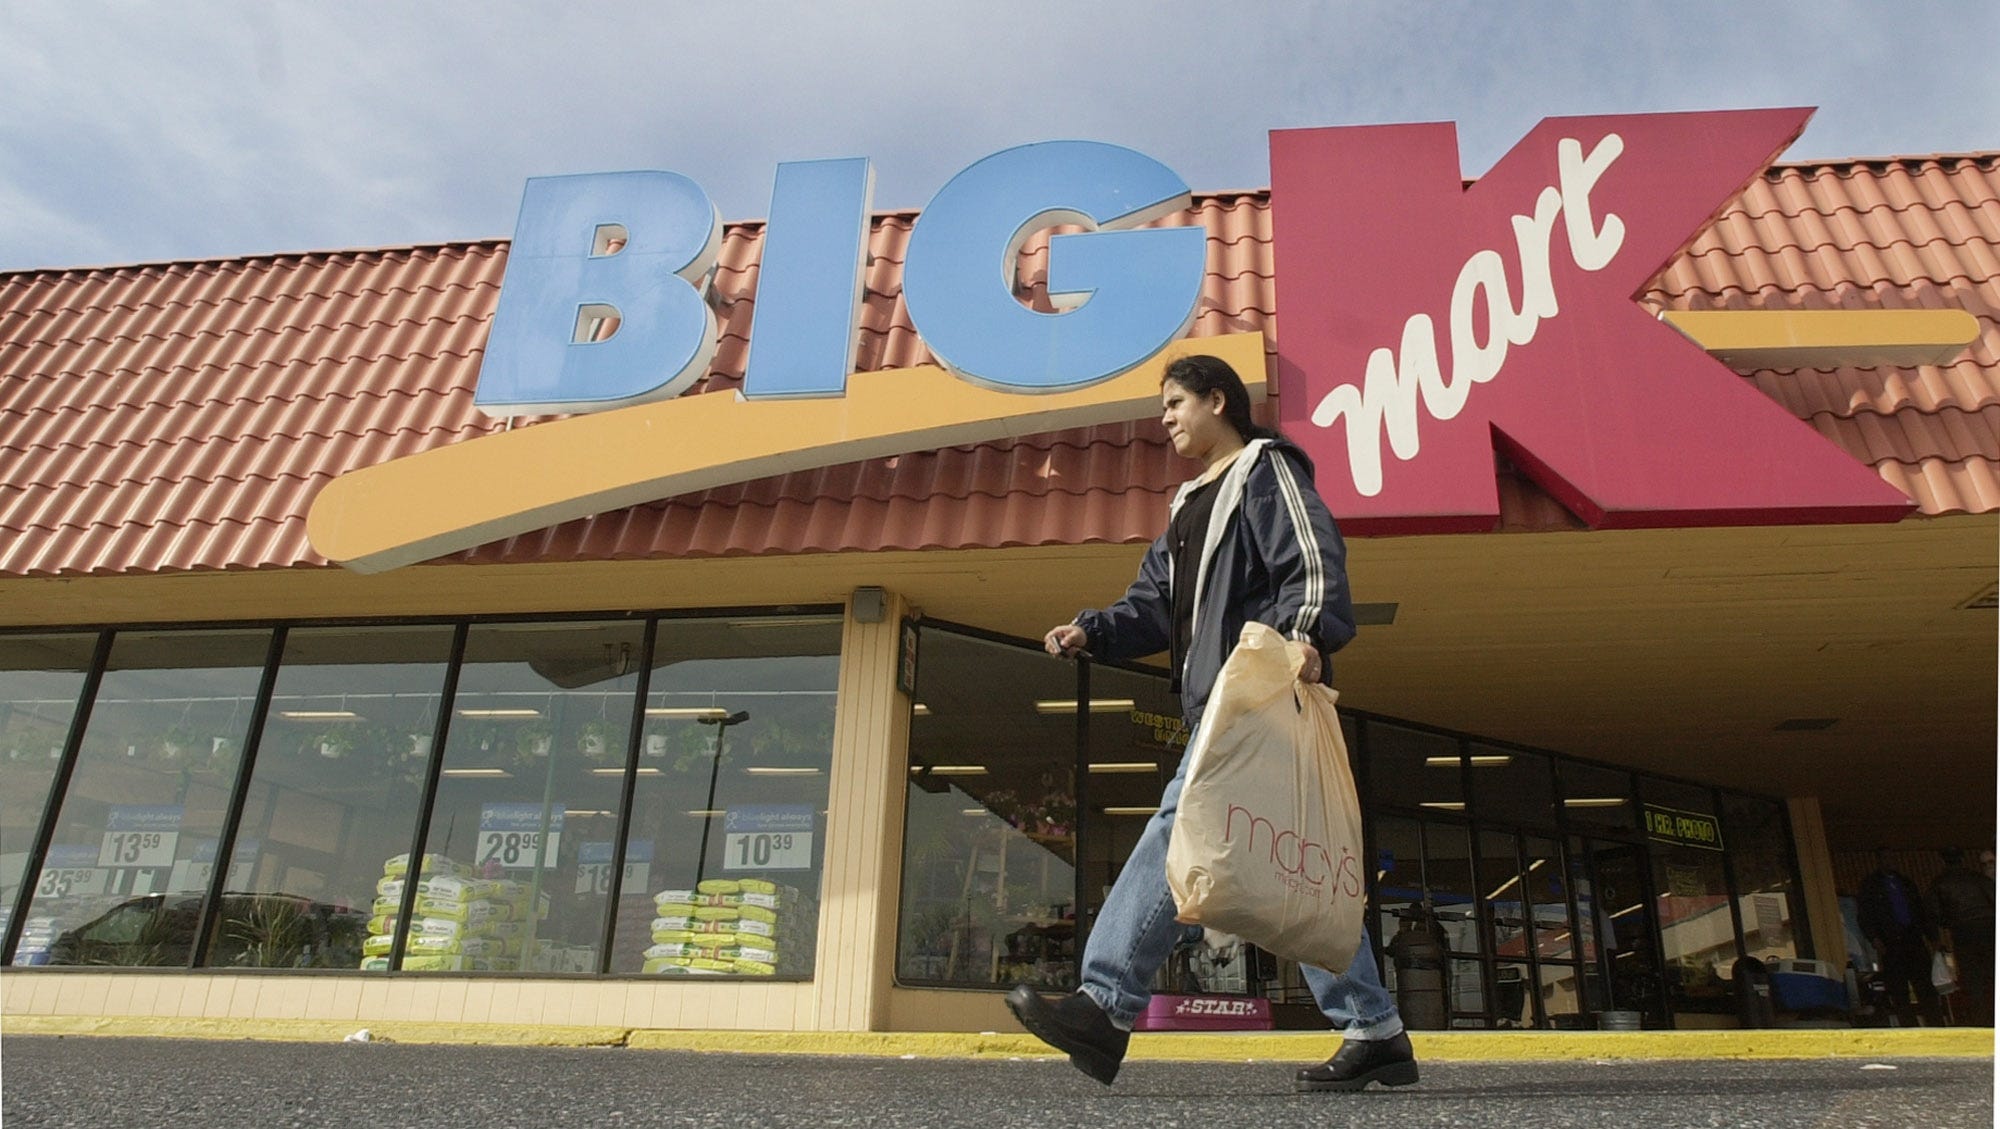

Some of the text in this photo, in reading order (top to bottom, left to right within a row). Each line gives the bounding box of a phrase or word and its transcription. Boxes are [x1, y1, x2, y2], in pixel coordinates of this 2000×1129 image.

[474, 106, 1916, 533] BIG K
[1311, 133, 1625, 497] mart
[1130, 709, 1182, 730] WESTE
[1225, 803, 1360, 905] macy's
[1676, 816, 1715, 843] PHOTO
[1190, 998, 1246, 1016] STAR
